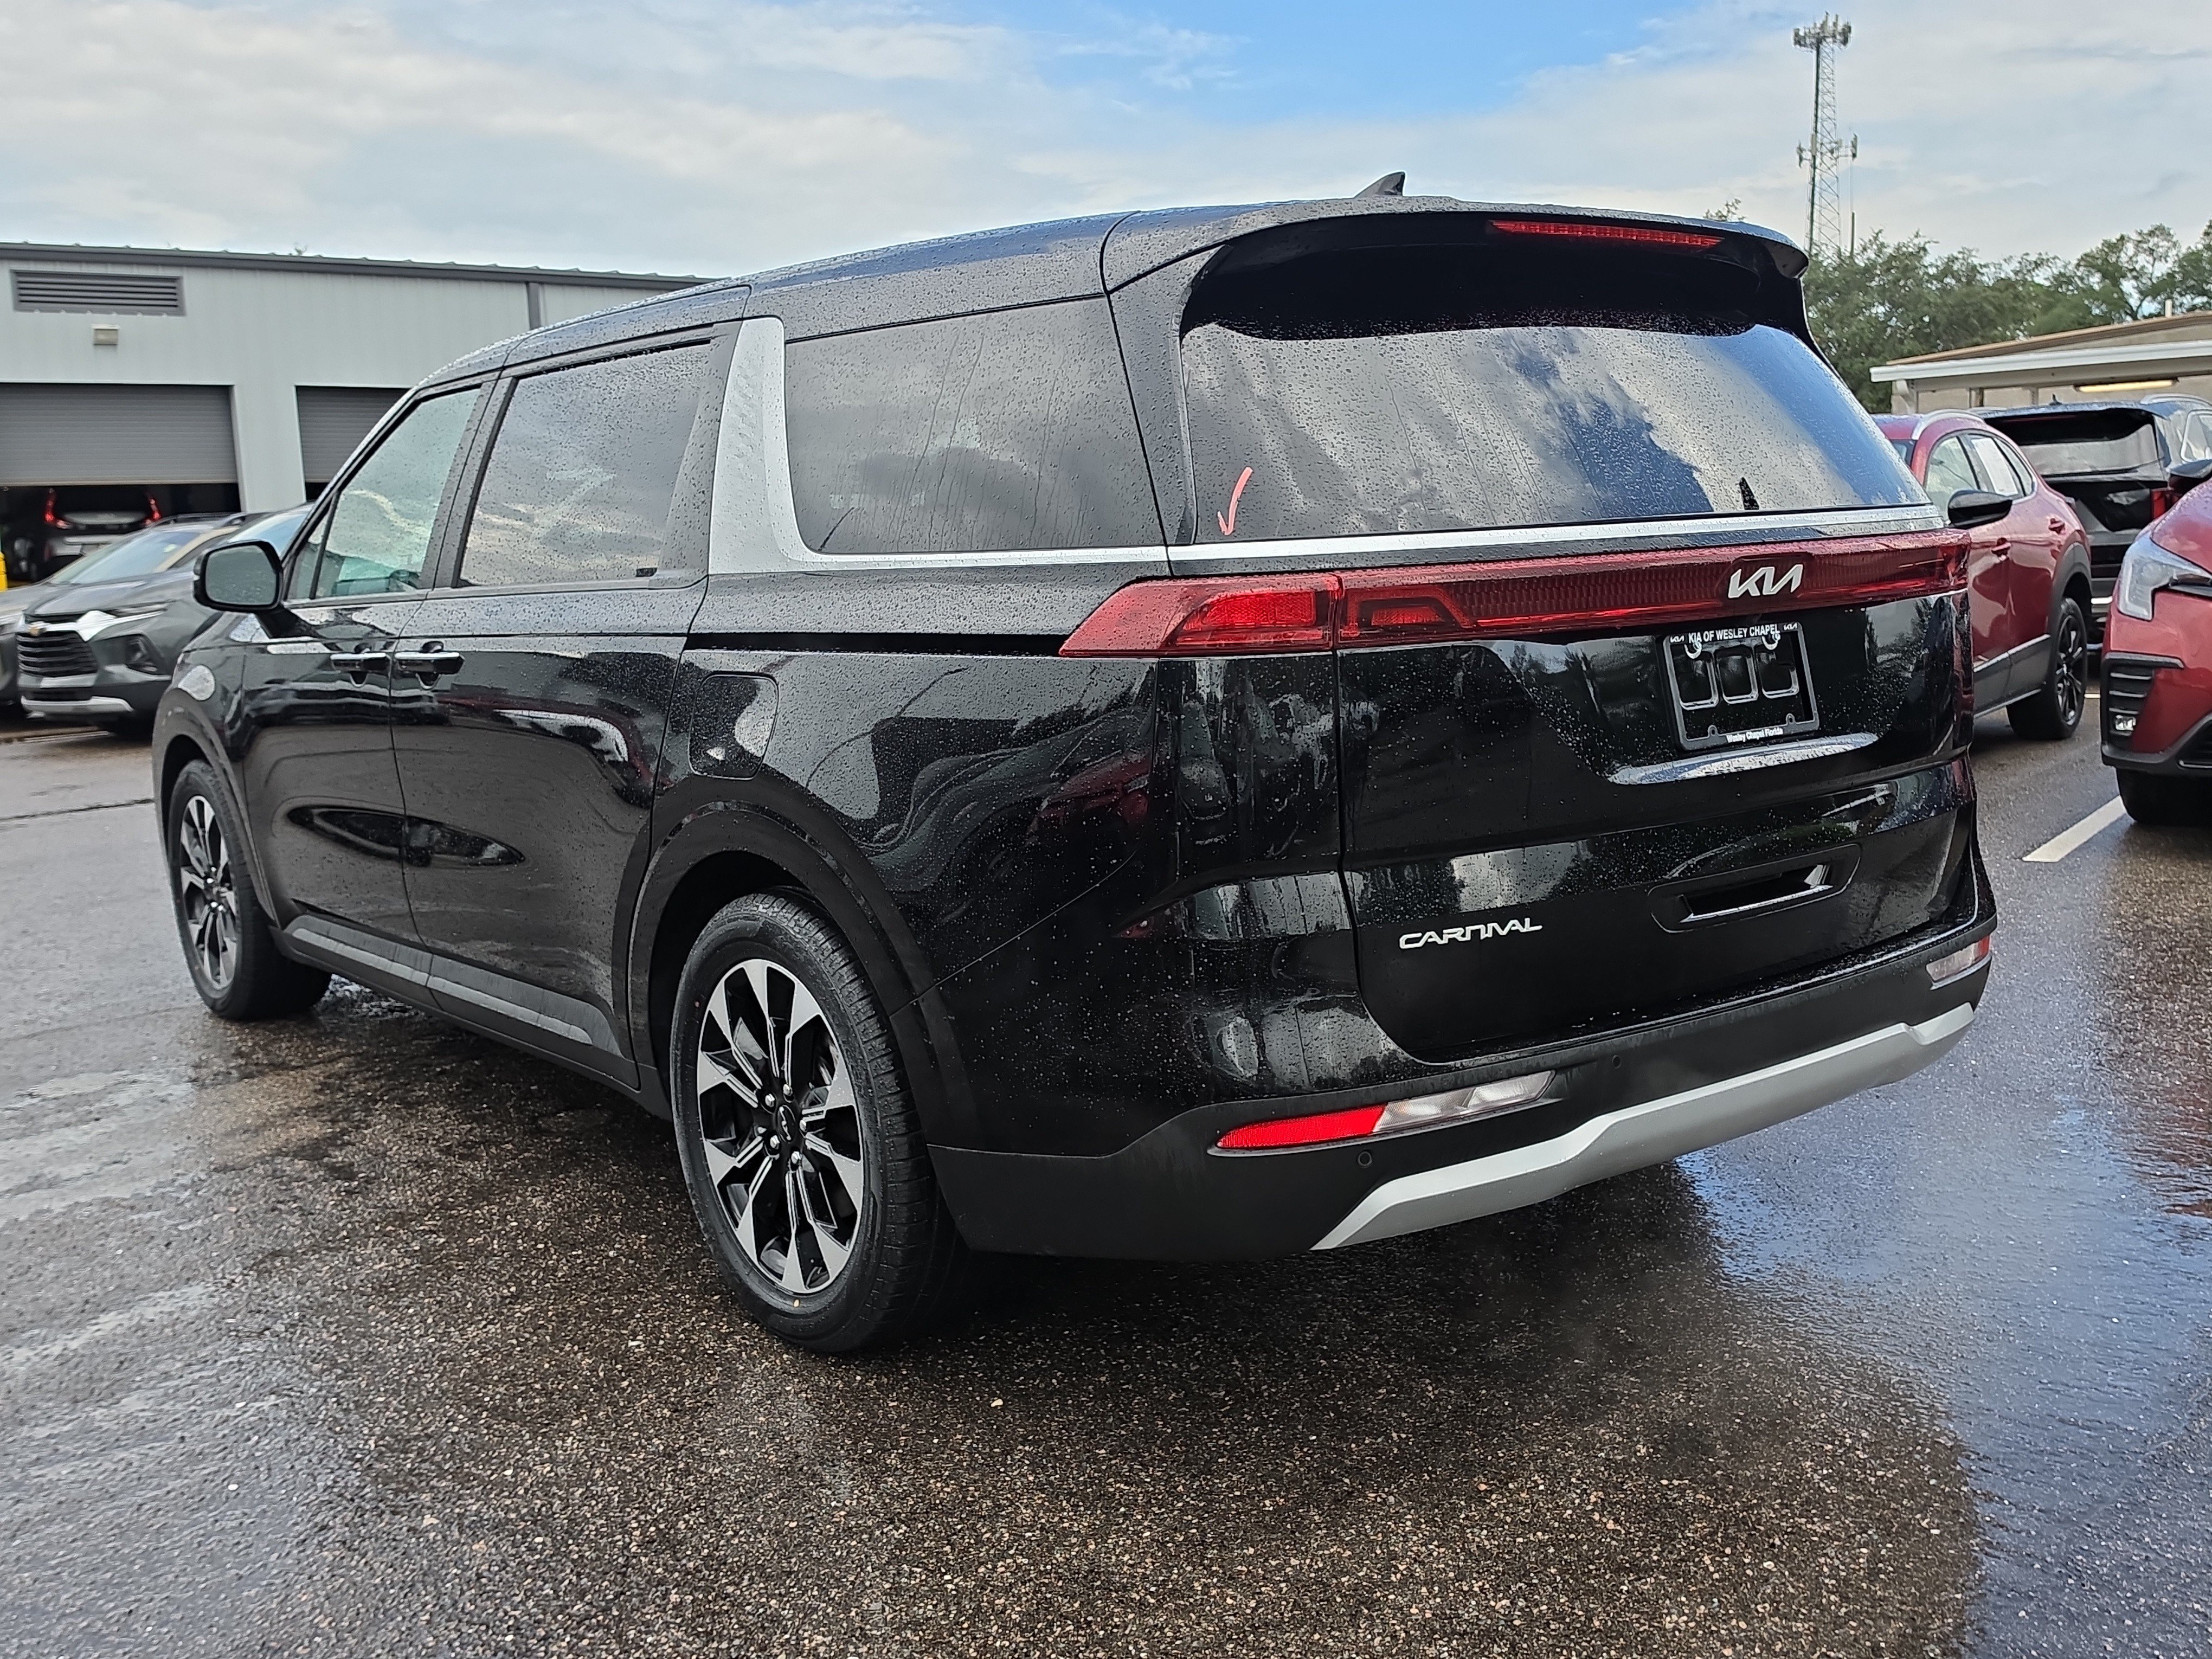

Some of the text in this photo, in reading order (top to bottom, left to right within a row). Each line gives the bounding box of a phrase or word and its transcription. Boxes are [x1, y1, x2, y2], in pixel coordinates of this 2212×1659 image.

[1728, 564, 1803, 599] KIA
[1688, 623, 1780, 644] KIA OF WESLEY CHAPEL
[1726, 727, 1784, 743] Wesley Chapel Florida
[1399, 917, 1543, 949] CARNIVAL
